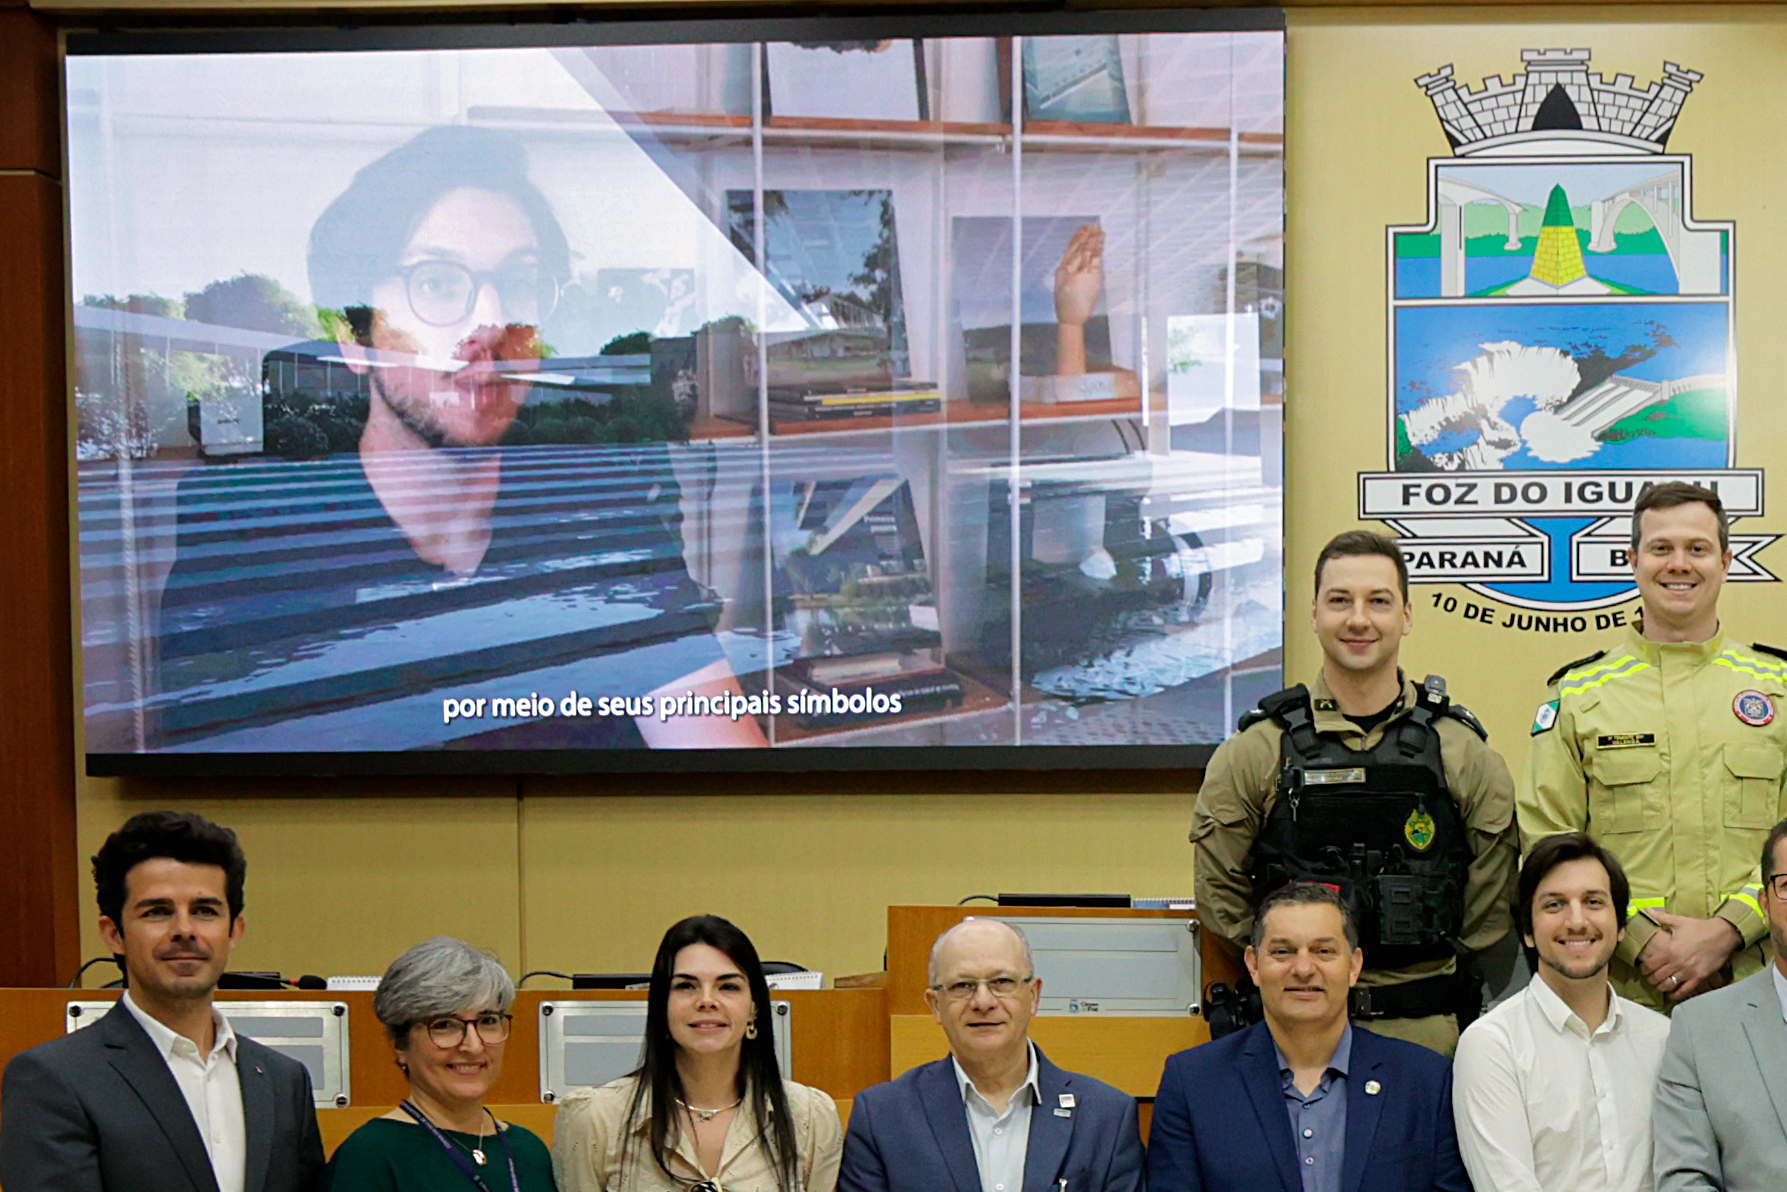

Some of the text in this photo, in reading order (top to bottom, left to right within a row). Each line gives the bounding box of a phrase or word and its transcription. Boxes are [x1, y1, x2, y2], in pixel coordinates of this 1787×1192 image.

[1402, 482, 1479, 506] FOZ
[1493, 481, 1548, 505] DO
[1402, 544, 1527, 569] PARANÁ
[1431, 592, 1458, 613] 10
[1463, 602, 1496, 625] DE
[1501, 613, 1587, 633] JUNHO
[1595, 610, 1627, 631] DE
[443, 697, 486, 724] por
[491, 692, 555, 717] meio
[560, 690, 593, 717] de
[598, 696, 654, 717] seus
[660, 690, 782, 722] principais
[787, 687, 902, 715] símbolos
